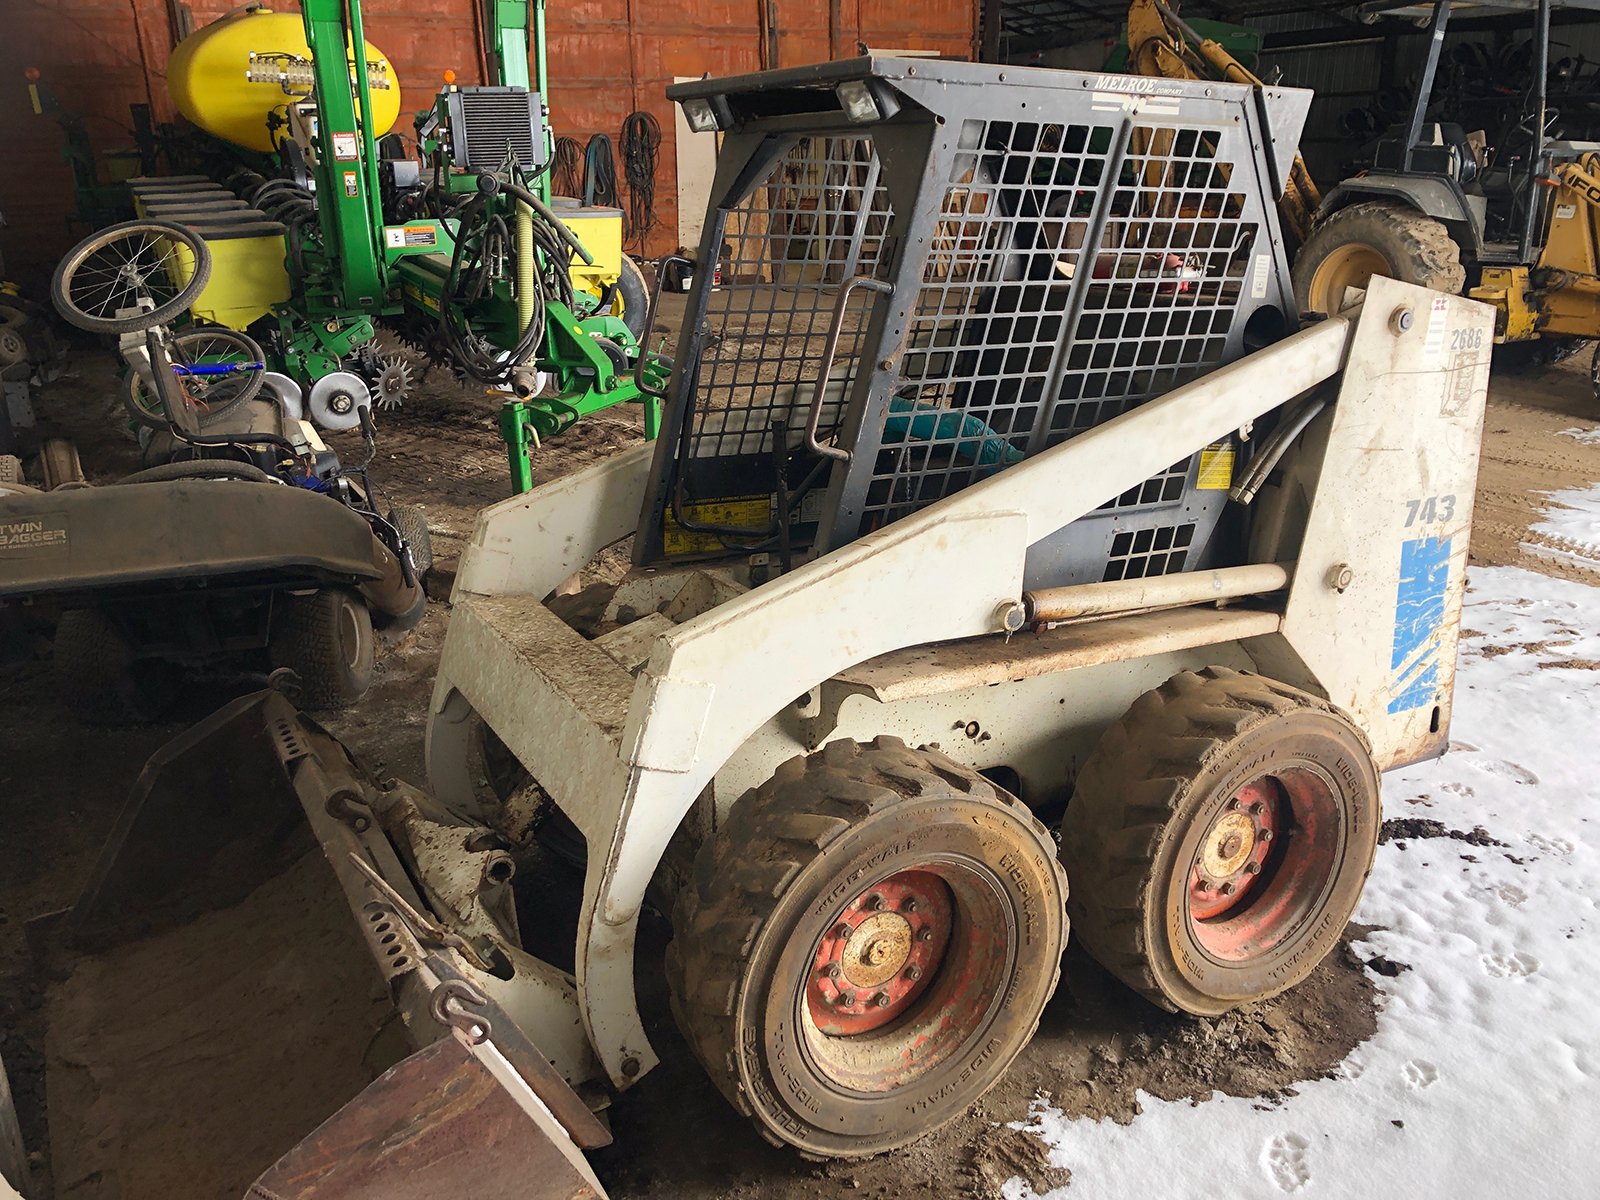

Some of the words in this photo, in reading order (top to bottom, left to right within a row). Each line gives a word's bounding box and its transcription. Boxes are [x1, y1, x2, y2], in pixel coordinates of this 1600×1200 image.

[1095, 75, 1158, 93] MELROE
[1156, 87, 1183, 96] COMPANY
[1450, 328, 1483, 350] 2686
[1404, 494, 1456, 528] 743
[0, 521, 43, 535] TWIN
[0, 529, 66, 545] BAGGER
[1335, 757, 1363, 833] WIDE-WALL
[999, 853, 1039, 946] WIDE-WALL
[1267, 912, 1332, 978] WIDE-WALL
